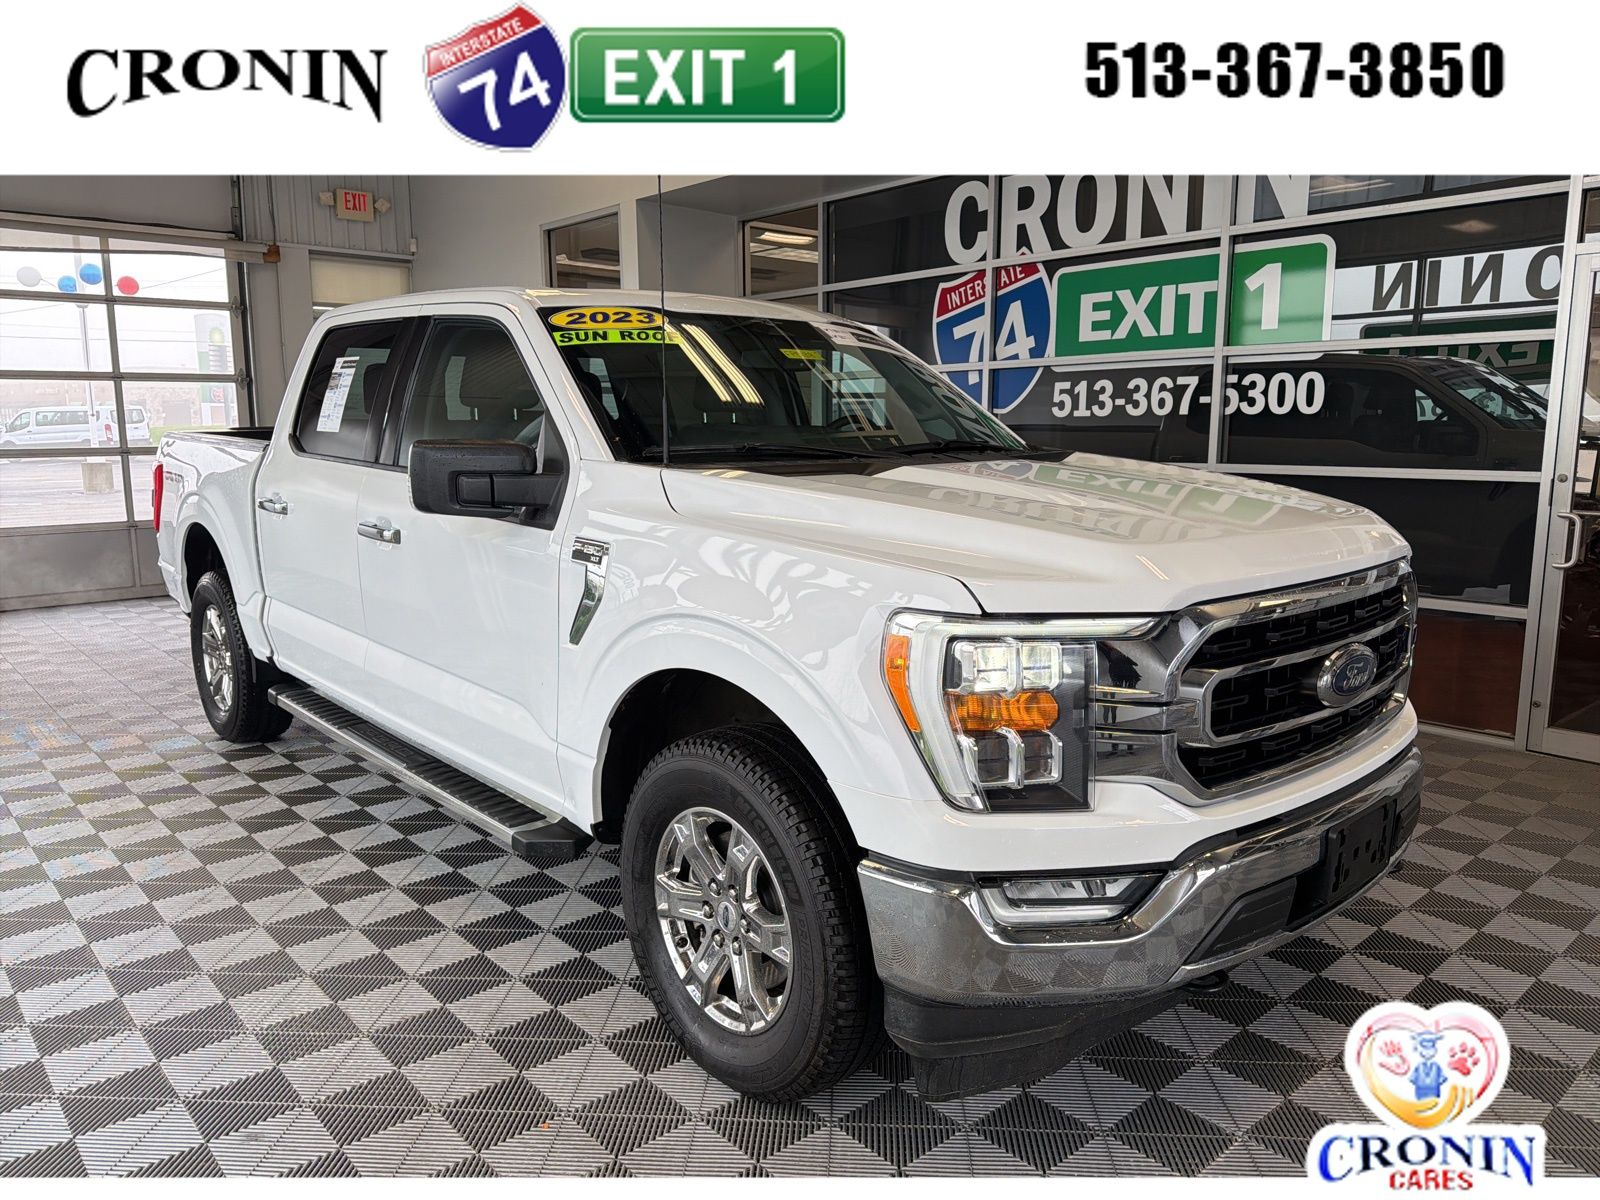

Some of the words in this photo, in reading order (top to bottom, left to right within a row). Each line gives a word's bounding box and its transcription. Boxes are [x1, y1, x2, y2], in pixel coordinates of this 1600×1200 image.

[343, 191, 368, 212] EXIT
[946, 265, 1026, 310] INTERATE
[1078, 280, 1219, 342] EXIT
[1244, 262, 1283, 330] 1
[565, 311, 657, 325] 2023
[558, 331, 608, 343] SUN
[952, 300, 1036, 386] 74
[1051, 371, 1326, 418] 513-367-5300
[1343, 661, 1370, 690] Ford
